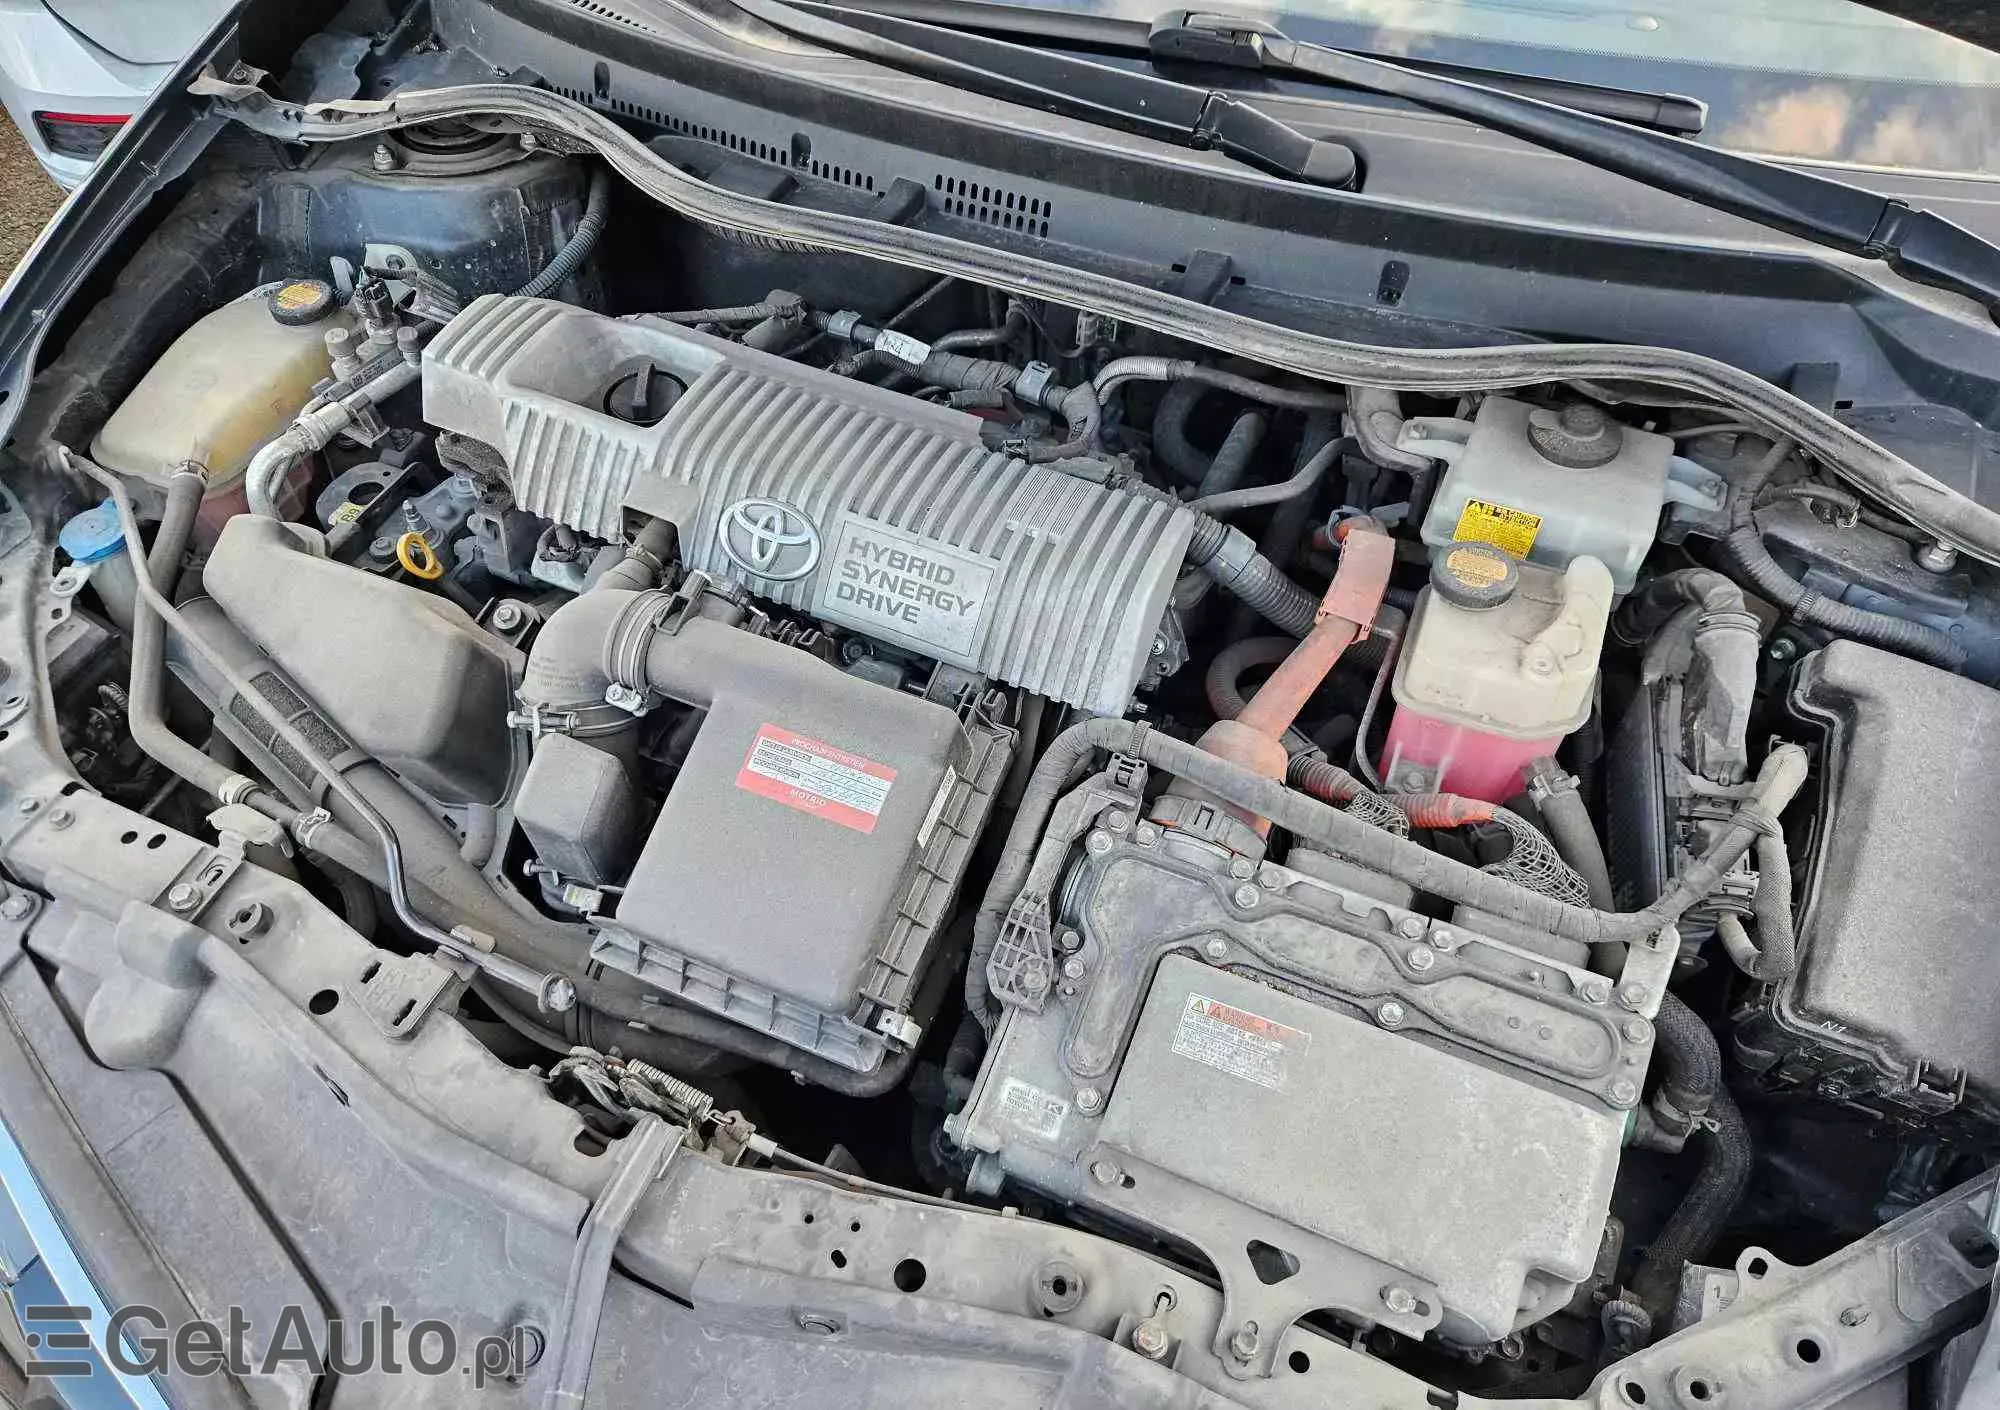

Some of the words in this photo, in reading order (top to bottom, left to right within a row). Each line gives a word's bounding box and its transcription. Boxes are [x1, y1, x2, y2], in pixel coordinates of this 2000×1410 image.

[848, 536, 955, 586] HYBRID
[836, 581, 921, 624] DRIVE
[841, 559, 975, 617] SYNERGY
[790, 789, 826, 806] MOTRIO
